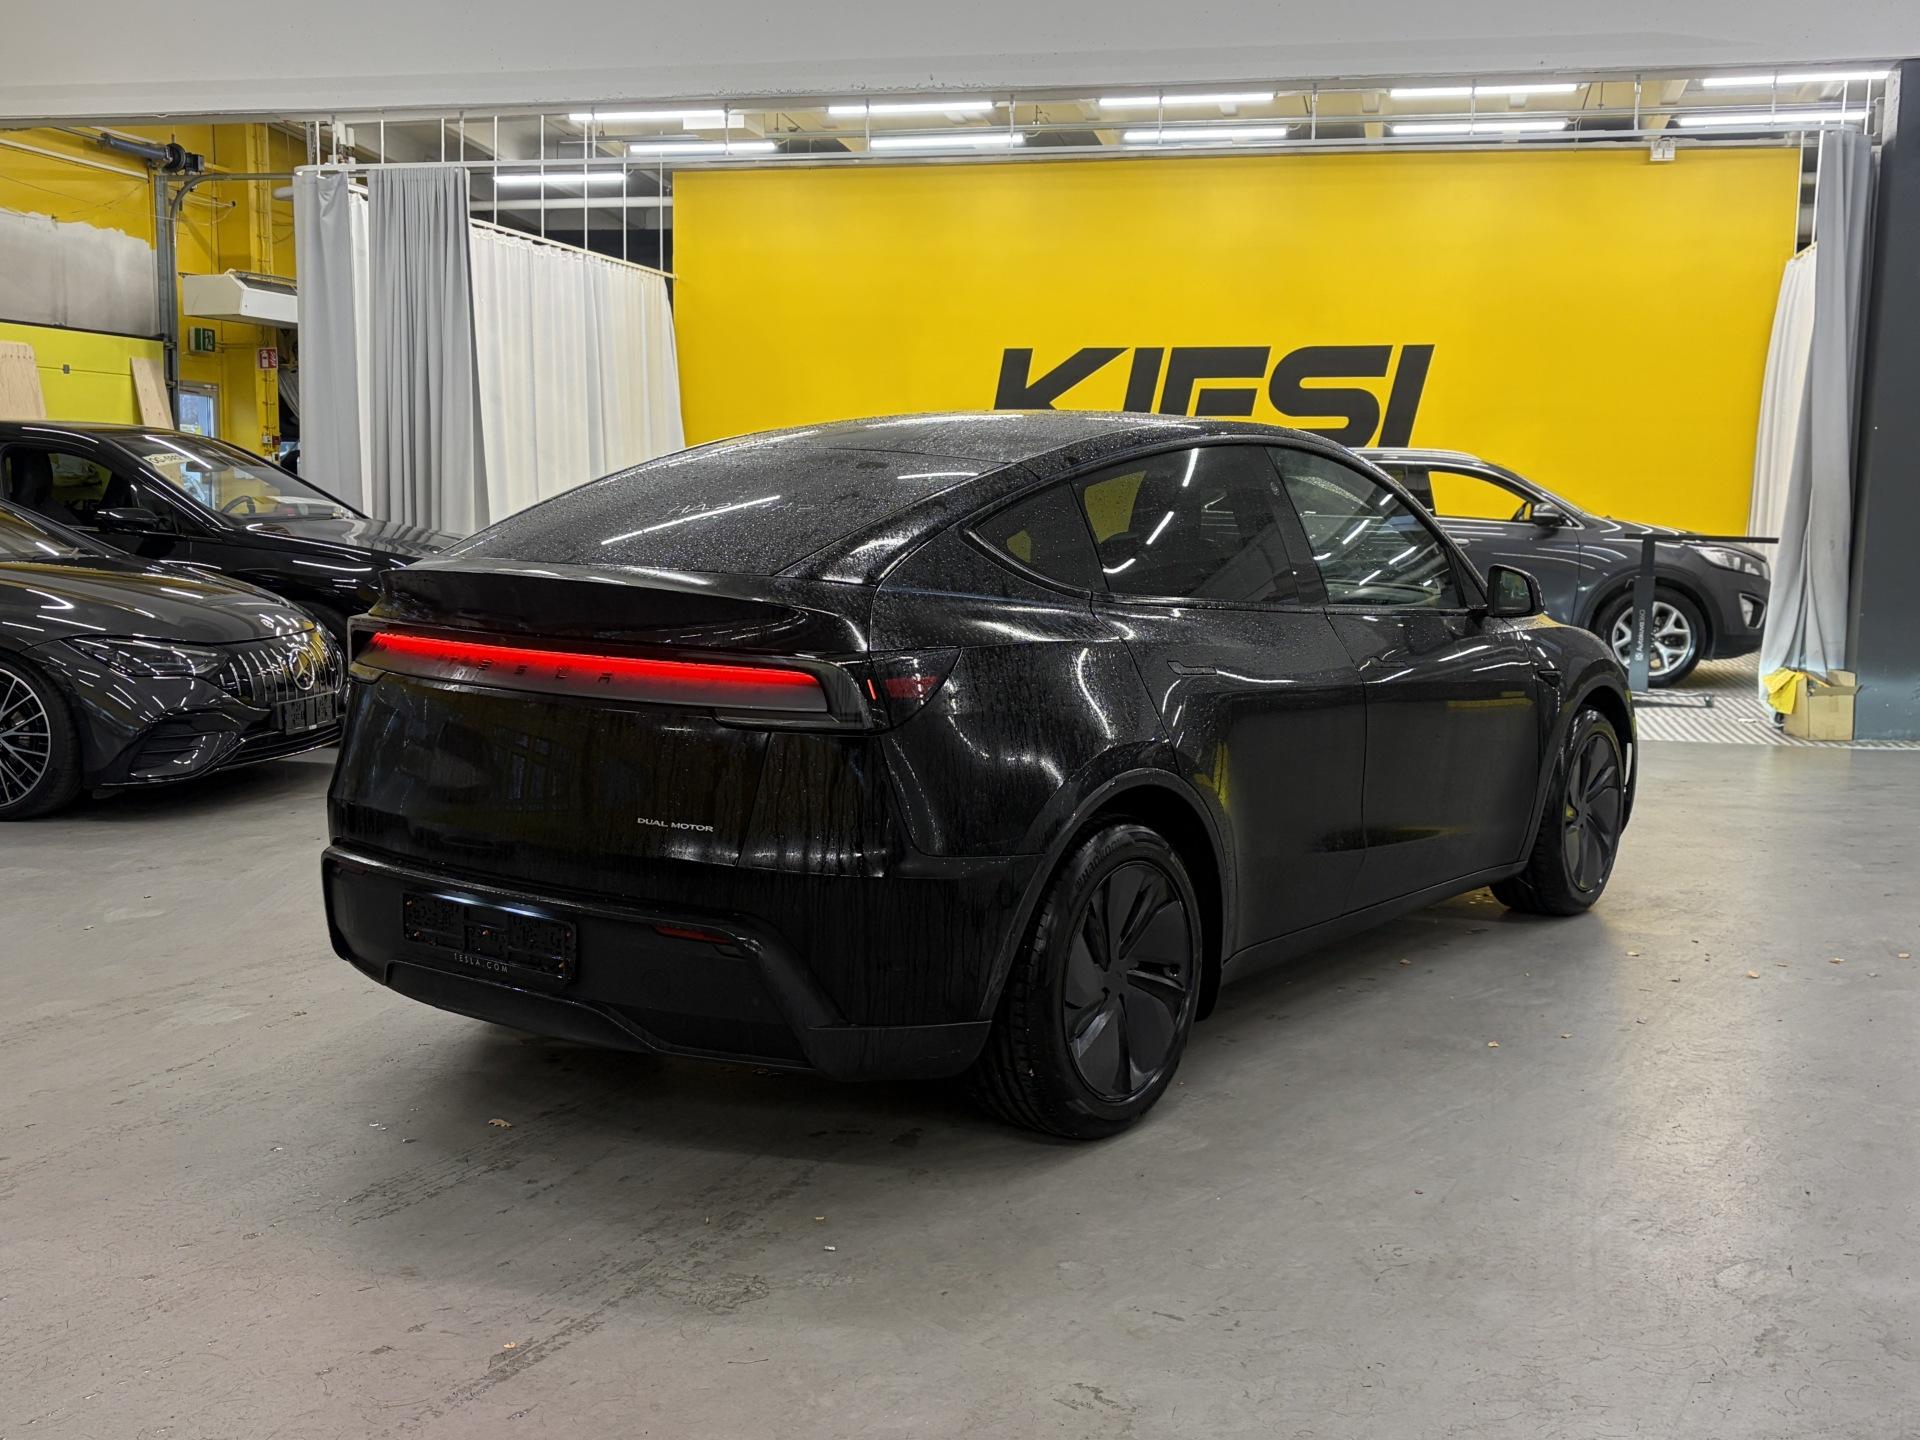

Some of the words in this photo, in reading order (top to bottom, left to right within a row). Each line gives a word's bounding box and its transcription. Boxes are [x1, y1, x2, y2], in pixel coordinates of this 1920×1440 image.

[993, 344, 1436, 448] KIESI
[637, 817, 669, 828] DUAL
[670, 822, 714, 833] MOTOR
